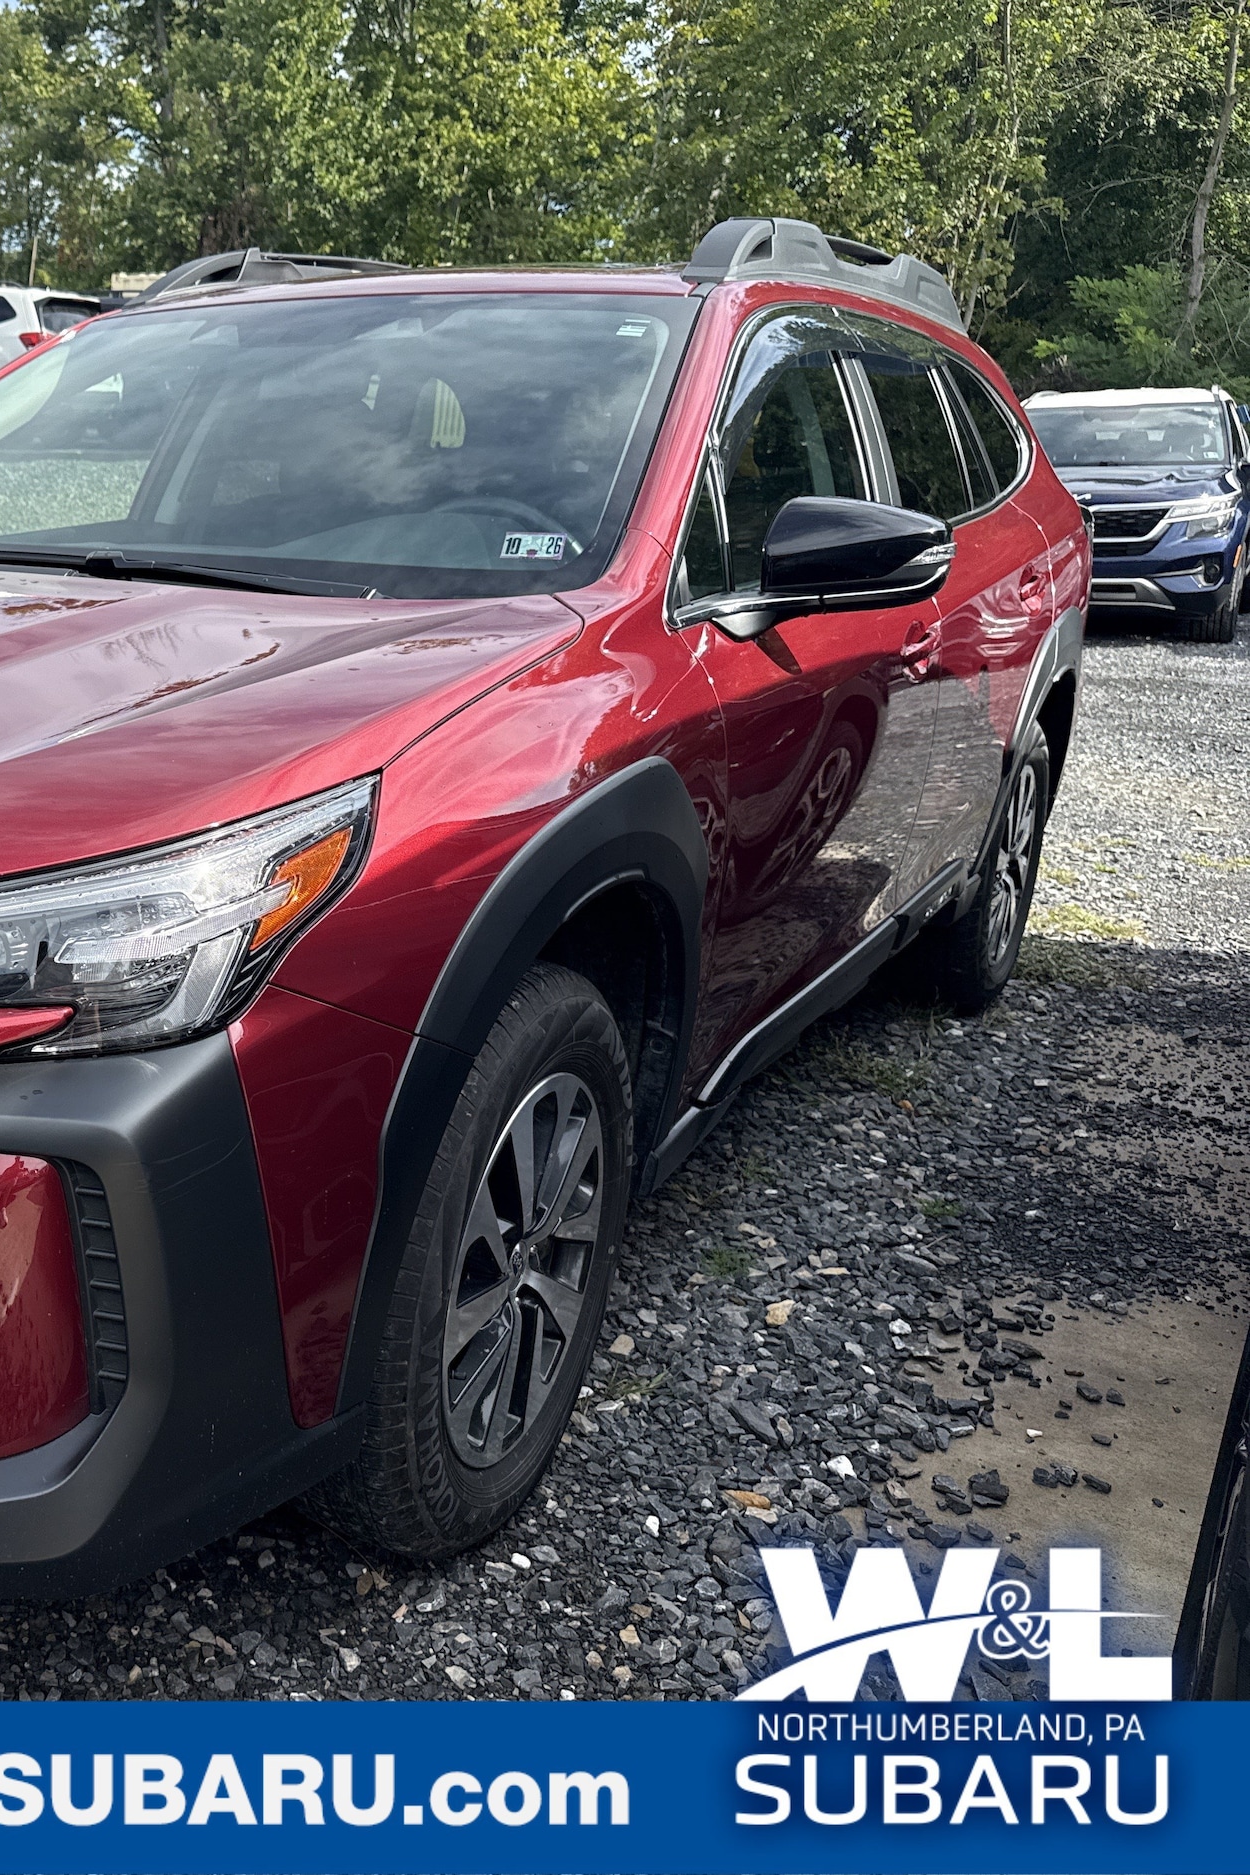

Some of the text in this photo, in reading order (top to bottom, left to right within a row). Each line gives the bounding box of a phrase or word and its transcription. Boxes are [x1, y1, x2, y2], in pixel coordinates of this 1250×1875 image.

[505, 536, 563, 555] 10 26
[417, 1330, 459, 1531] YOKOHAMA
